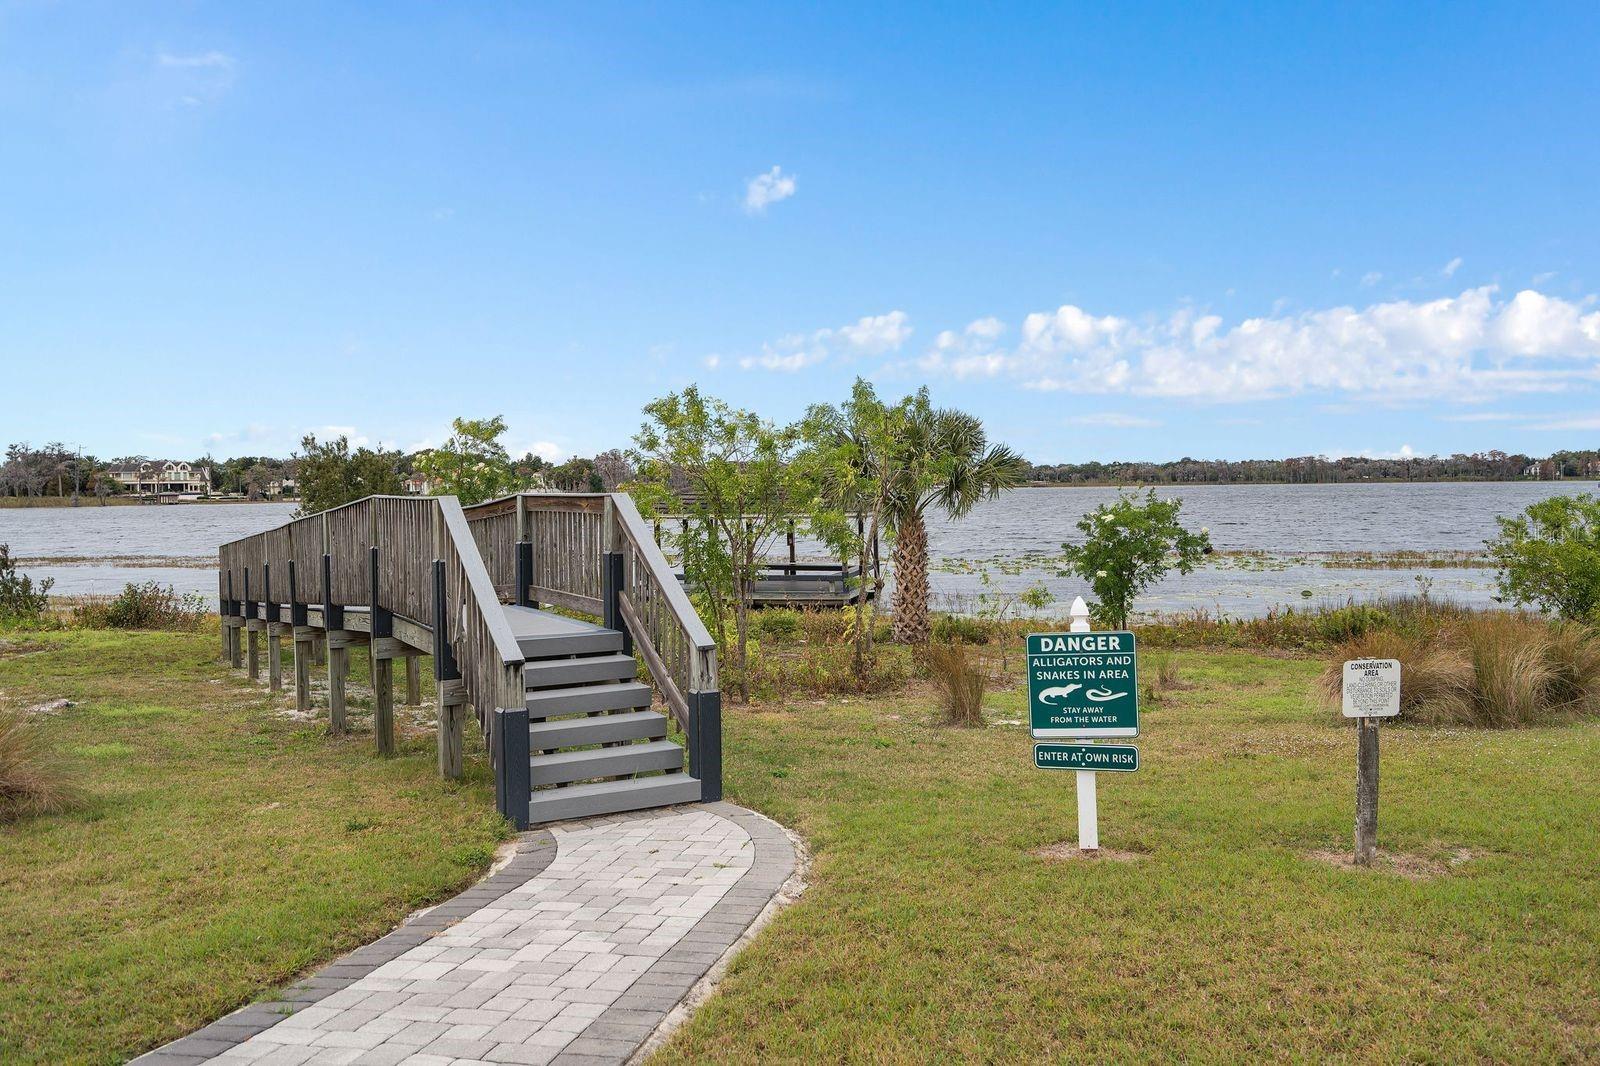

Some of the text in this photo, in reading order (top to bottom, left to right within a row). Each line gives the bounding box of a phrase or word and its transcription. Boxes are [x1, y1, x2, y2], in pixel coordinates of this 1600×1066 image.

[1040, 636, 1120, 652] DANGER
[1033, 656, 1131, 667] ALLIGATORS AND
[1350, 662, 1393, 670] CONSERVATION
[1036, 670, 1129, 680] SNAKES IN AREA
[1050, 716, 1072, 724] FROM
[1091, 715, 1118, 723] WATER
[1038, 751, 1134, 764] ENTER AT OWN RISK
